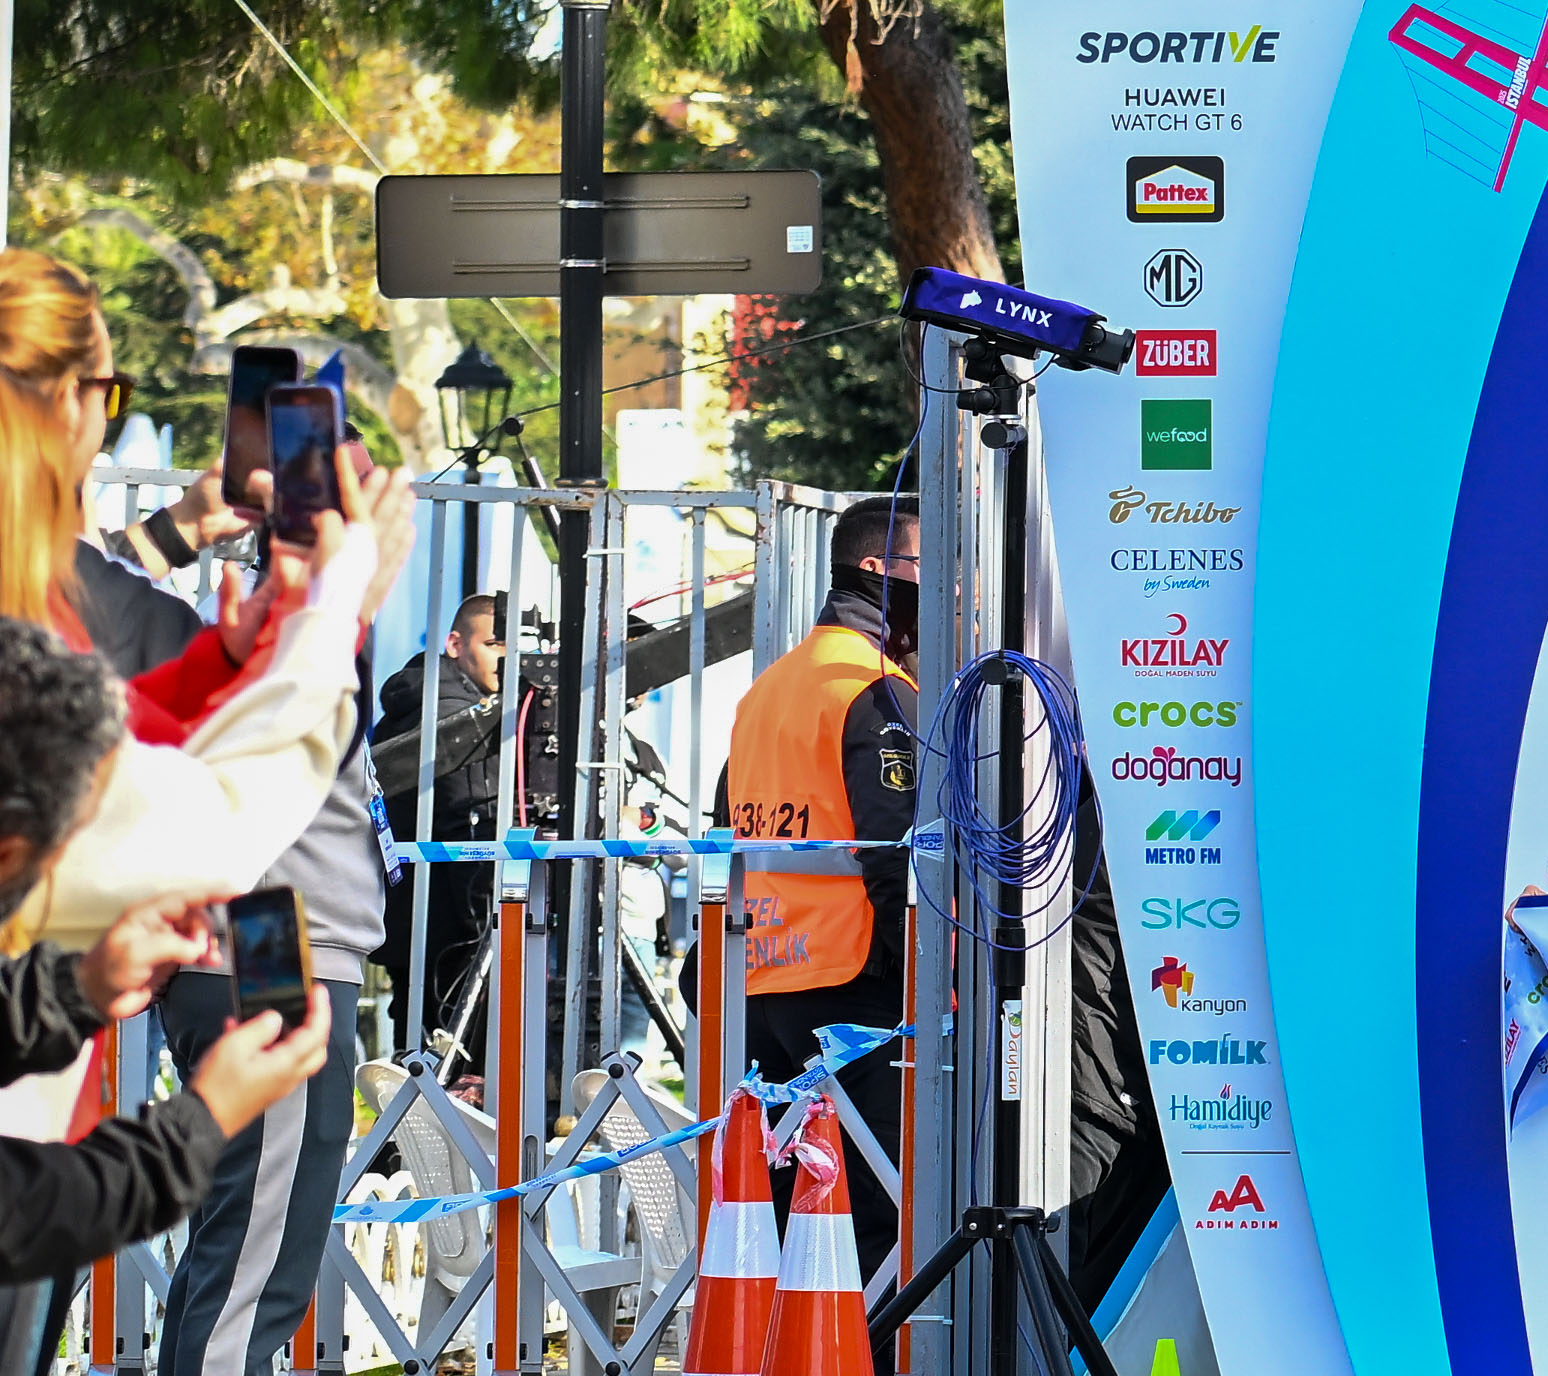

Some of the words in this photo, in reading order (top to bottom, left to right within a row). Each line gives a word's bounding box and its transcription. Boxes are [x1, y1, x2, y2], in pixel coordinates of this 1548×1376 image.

[1076, 25, 1280, 63] SPORTIVE
[1125, 89, 1225, 106] HUAWEI
[1111, 114, 1187, 131] WATCH
[1196, 114, 1224, 131] GT
[1231, 114, 1242, 131] 6
[1144, 183, 1208, 201] Pattex
[1150, 255, 1196, 302] MG
[995, 298, 1053, 329] LYNX
[1147, 428, 1206, 443] wefood
[1146, 502, 1241, 523] Tchibo
[1110, 549, 1243, 571] CELENES
[1144, 577, 1159, 597] by
[1162, 576, 1210, 591] Sweden
[1121, 640, 1229, 666] KIZILAY
[1113, 702, 1237, 727] crocs
[1146, 848, 1195, 864] METRO
[1200, 848, 1221, 864] FM
[1141, 898, 1240, 929] SKG
[1170, 1094, 1272, 1128] Hamidiye
[1196, 1220, 1233, 1229] ADIM
[1240, 1220, 1278, 1229] ADIM
